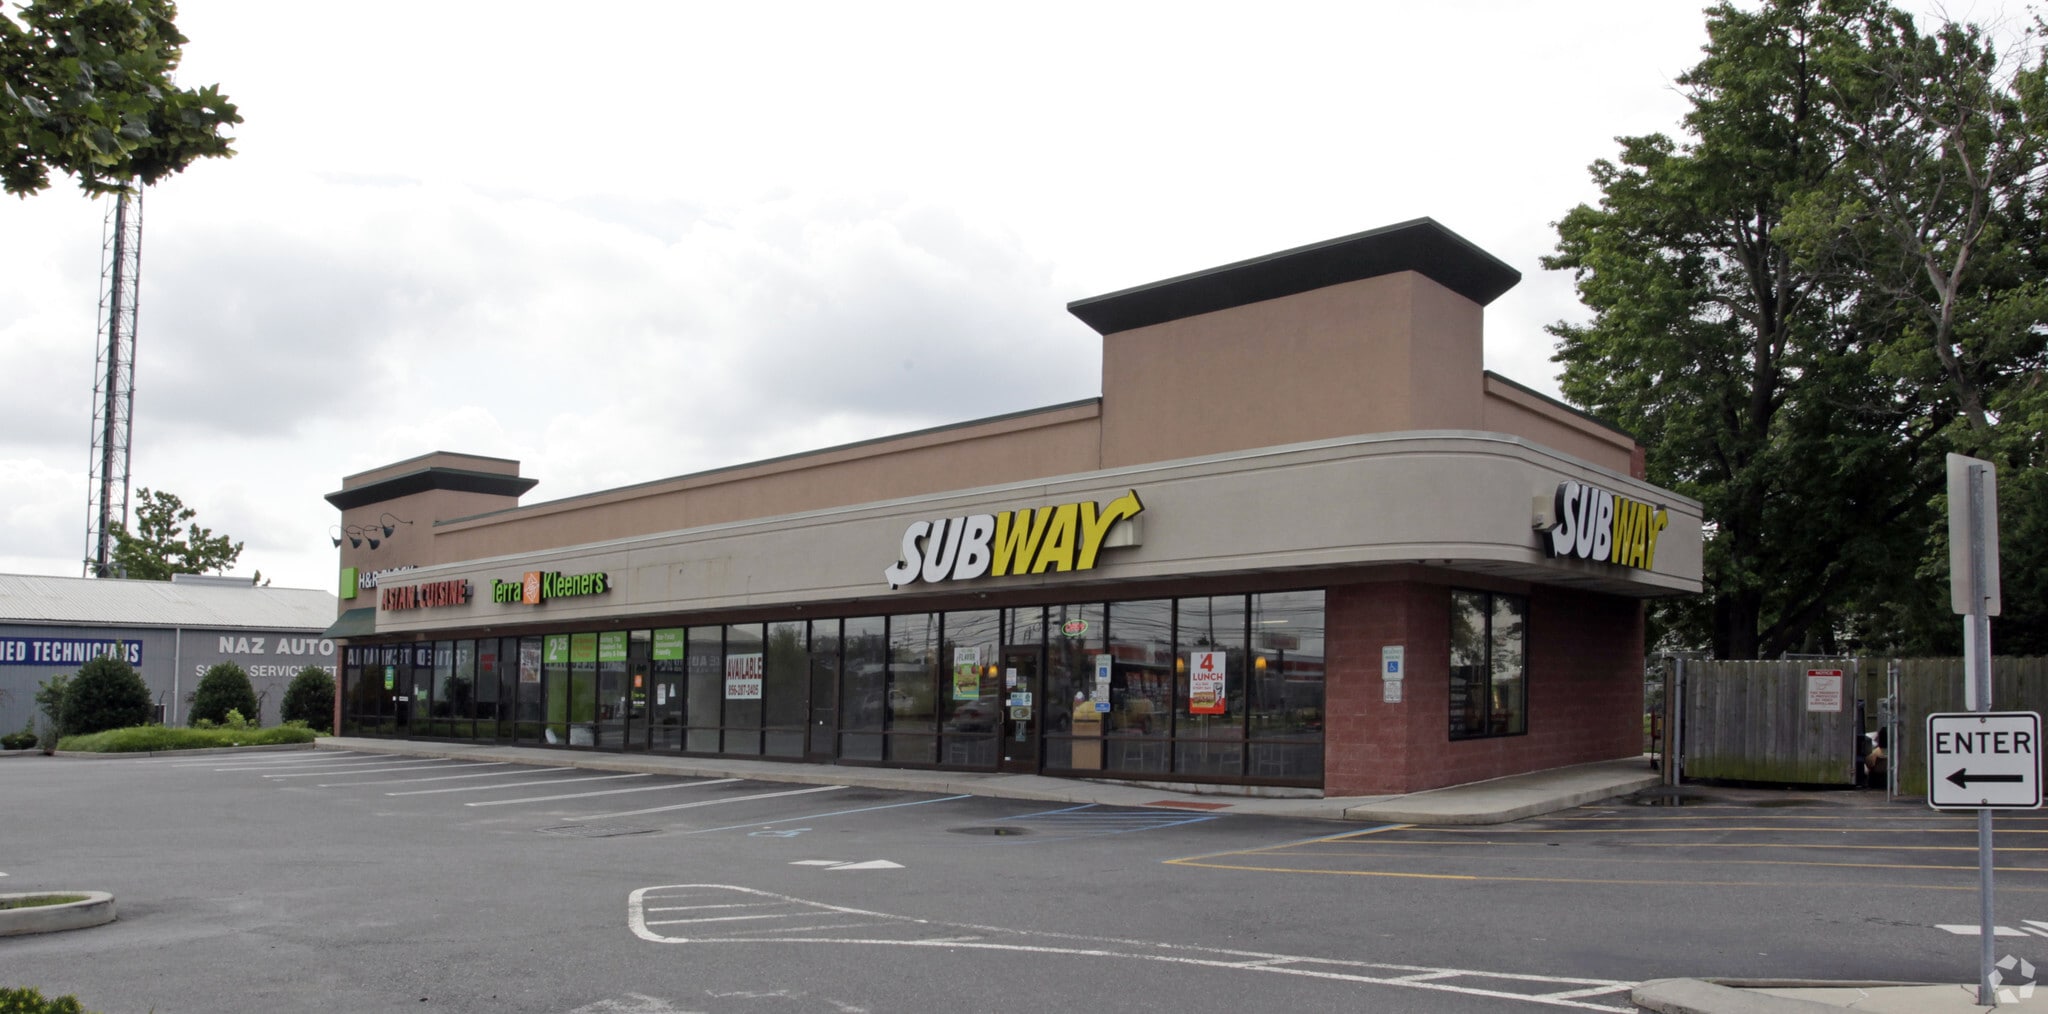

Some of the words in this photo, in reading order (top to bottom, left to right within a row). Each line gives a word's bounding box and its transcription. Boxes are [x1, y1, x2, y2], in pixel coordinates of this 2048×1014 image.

[1552, 480, 1668, 571] SUBWAY
[884, 489, 1145, 590] SUBWAY
[358, 570, 379, 590] H&R
[491, 579, 522, 603] Terra
[543, 571, 604, 599] Kleeners
[382, 585, 415, 611] ASIAN
[420, 579, 465, 608] CUISINE
[219, 636, 265, 654] NAZ
[276, 638, 334, 656] AUTO
[728, 656, 762, 679] AVAILABLE
[1193, 673, 1223, 681] LUNCH
[1936, 732, 2031, 754] ENTER
